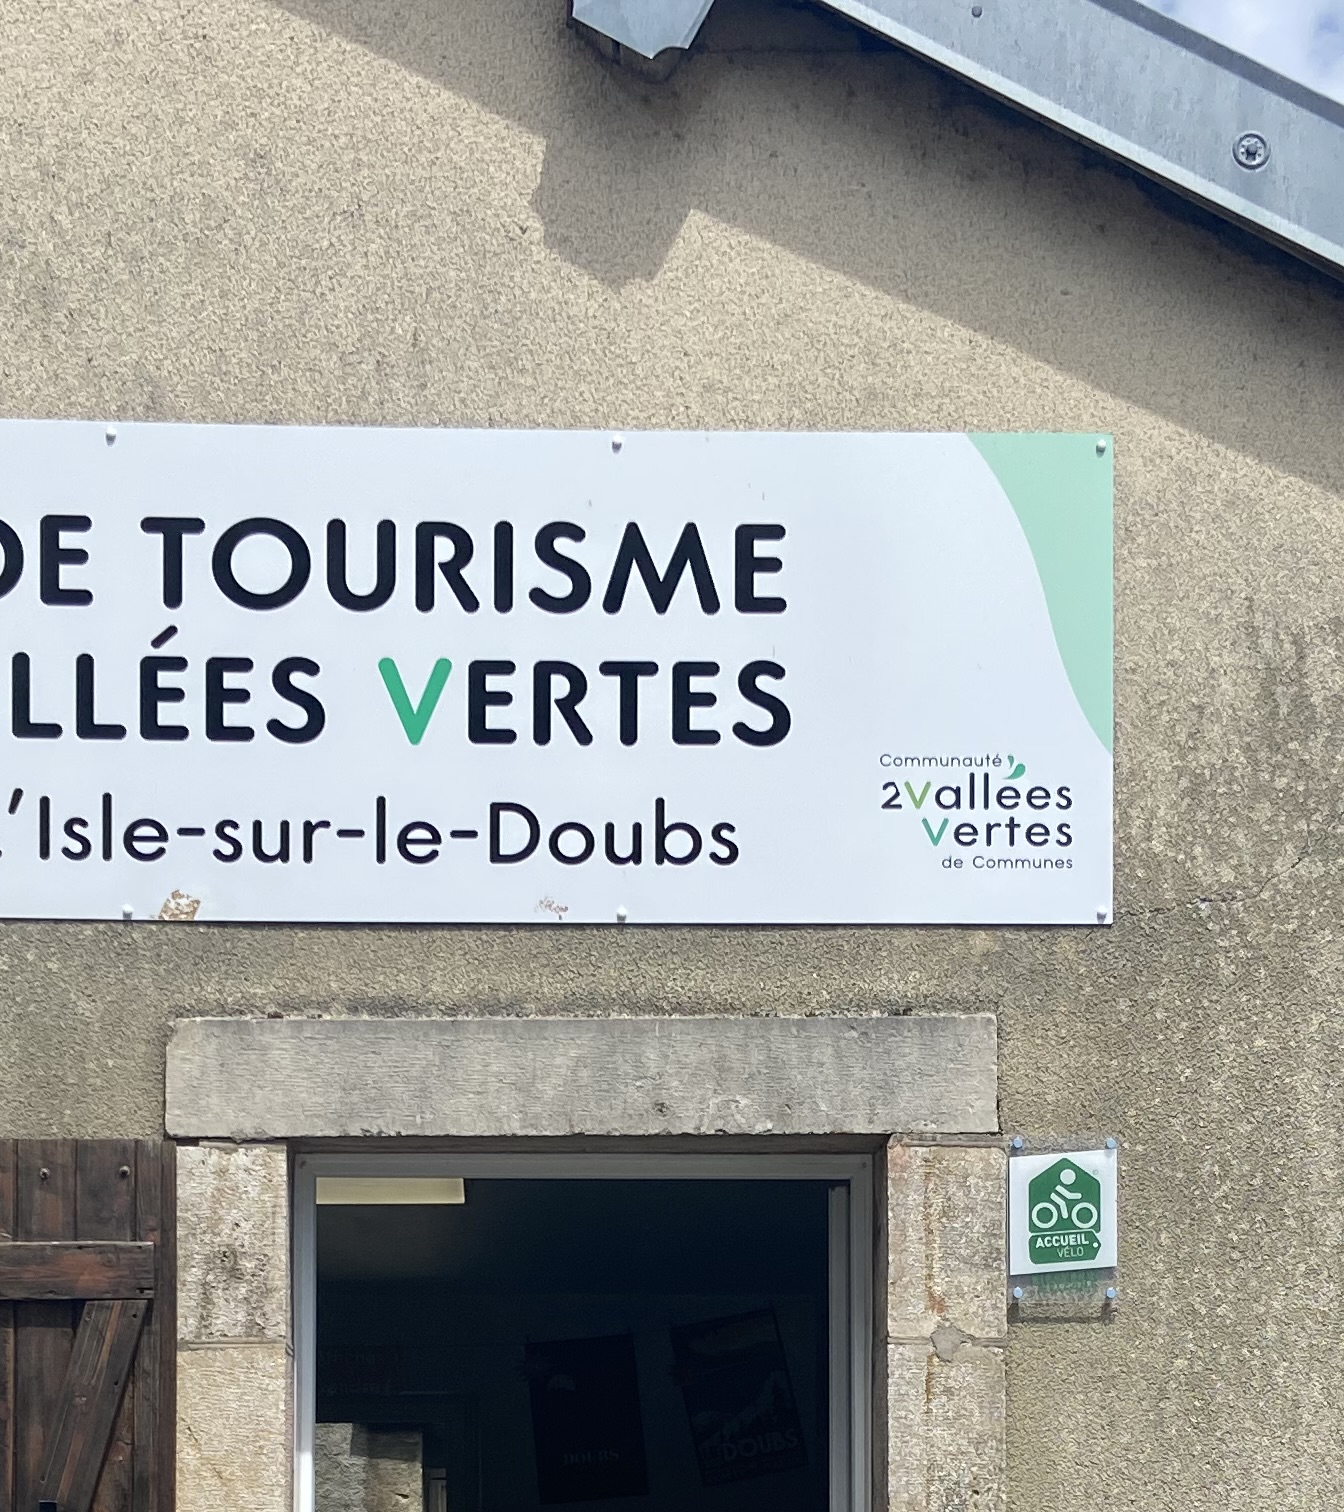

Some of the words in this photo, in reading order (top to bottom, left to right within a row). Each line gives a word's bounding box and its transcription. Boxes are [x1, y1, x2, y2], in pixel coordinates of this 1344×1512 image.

[140, 517, 787, 615] TOURISME
[378, 657, 791, 748] VERTES
[879, 753, 1002, 767] Communauté
[921, 816, 1073, 847] Vertes
[941, 855, 964, 869] de
[972, 855, 1074, 869] Communes
[1035, 1234, 1090, 1249] ACCUEIL
[1057, 1246, 1084, 1258] VÉLO
